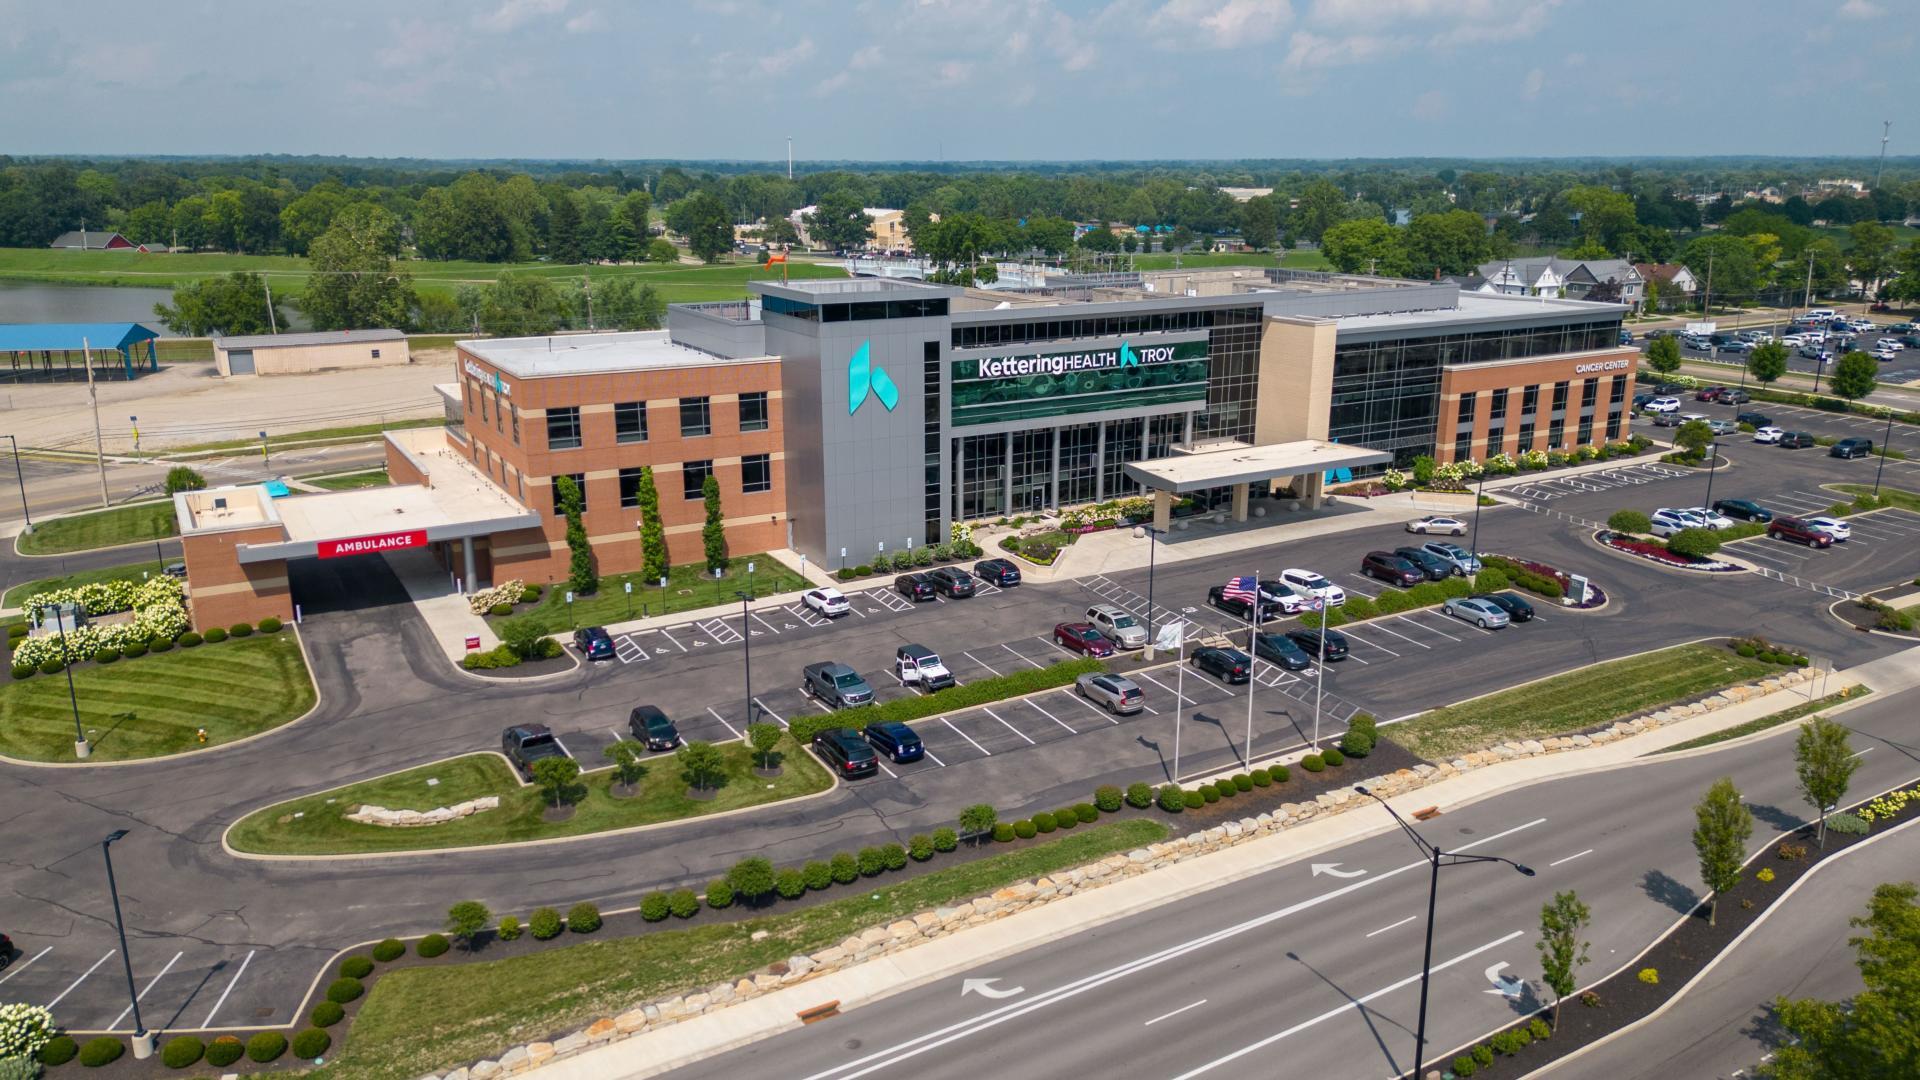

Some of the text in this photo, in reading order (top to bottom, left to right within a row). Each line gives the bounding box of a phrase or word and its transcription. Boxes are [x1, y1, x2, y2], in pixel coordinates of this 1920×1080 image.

[1140, 347, 1175, 363] TROY
[1576, 360, 1629, 373] CANCER CENTER
[335, 535, 412, 553] AMBULANCE
